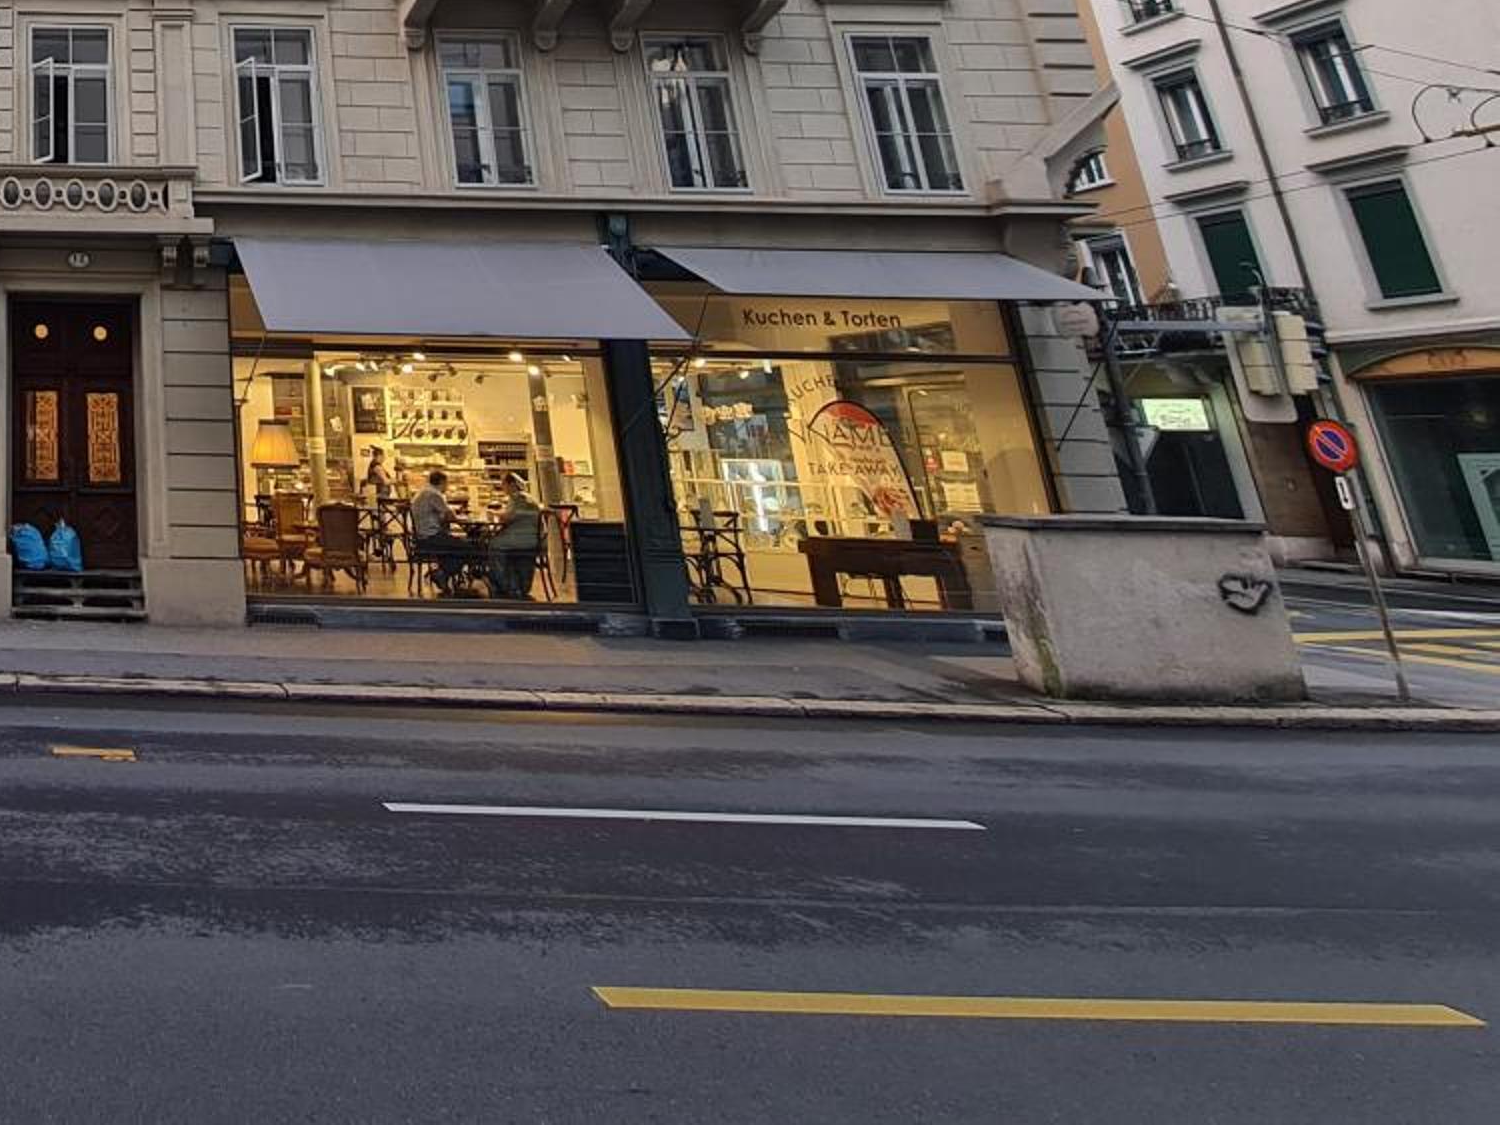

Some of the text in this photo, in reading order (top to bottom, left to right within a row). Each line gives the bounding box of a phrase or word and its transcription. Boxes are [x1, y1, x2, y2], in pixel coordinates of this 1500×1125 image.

[743, 308, 901, 328] Kuchen & Torten
